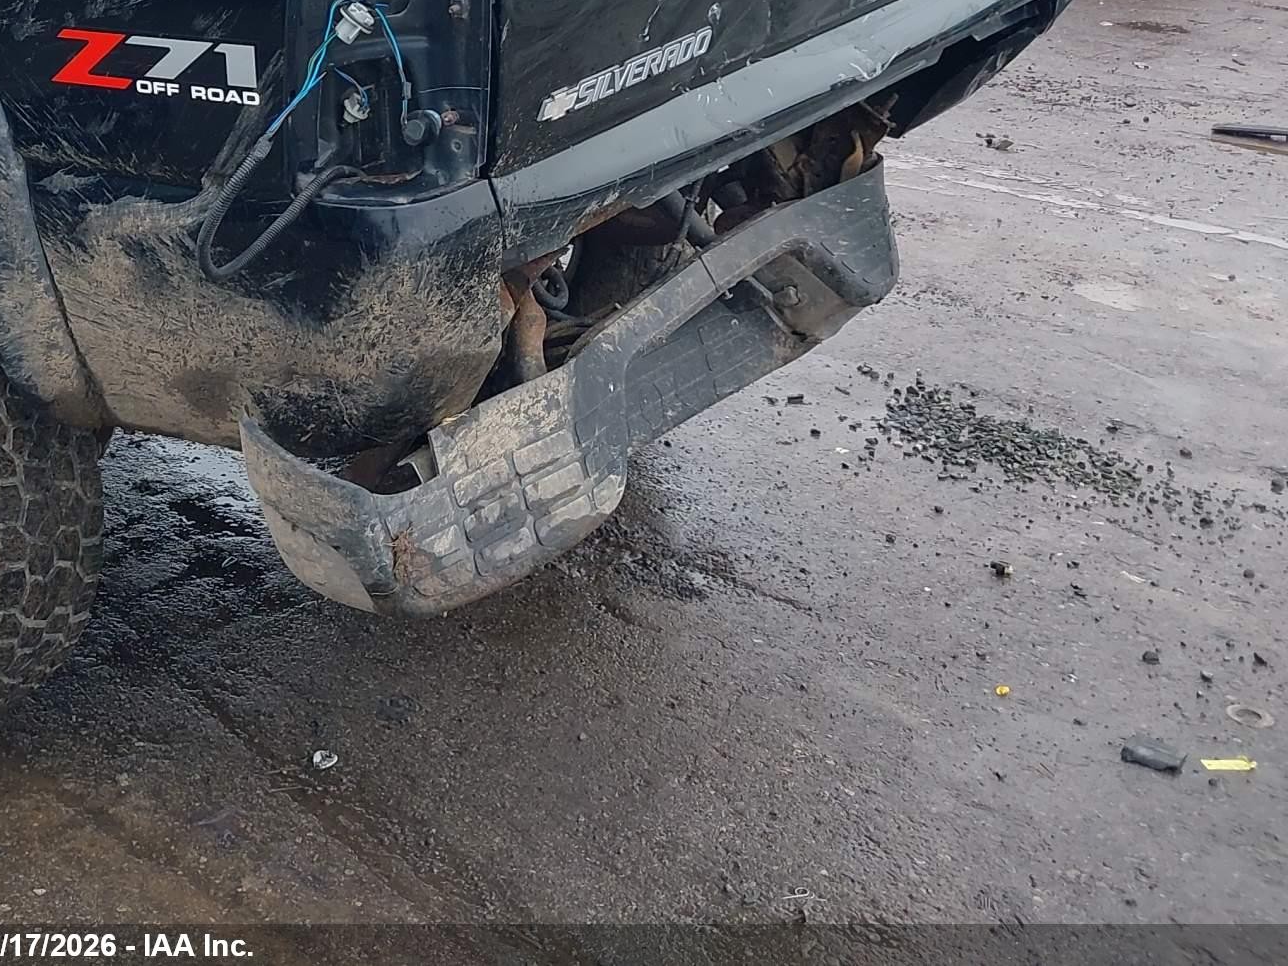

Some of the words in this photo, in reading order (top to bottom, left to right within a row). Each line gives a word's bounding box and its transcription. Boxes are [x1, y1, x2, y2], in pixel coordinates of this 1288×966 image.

[51, 29, 258, 89] Z71
[574, 26, 712, 110] SILVERADO
[136, 79, 180, 96] OFF
[191, 86, 260, 105] ROAD
